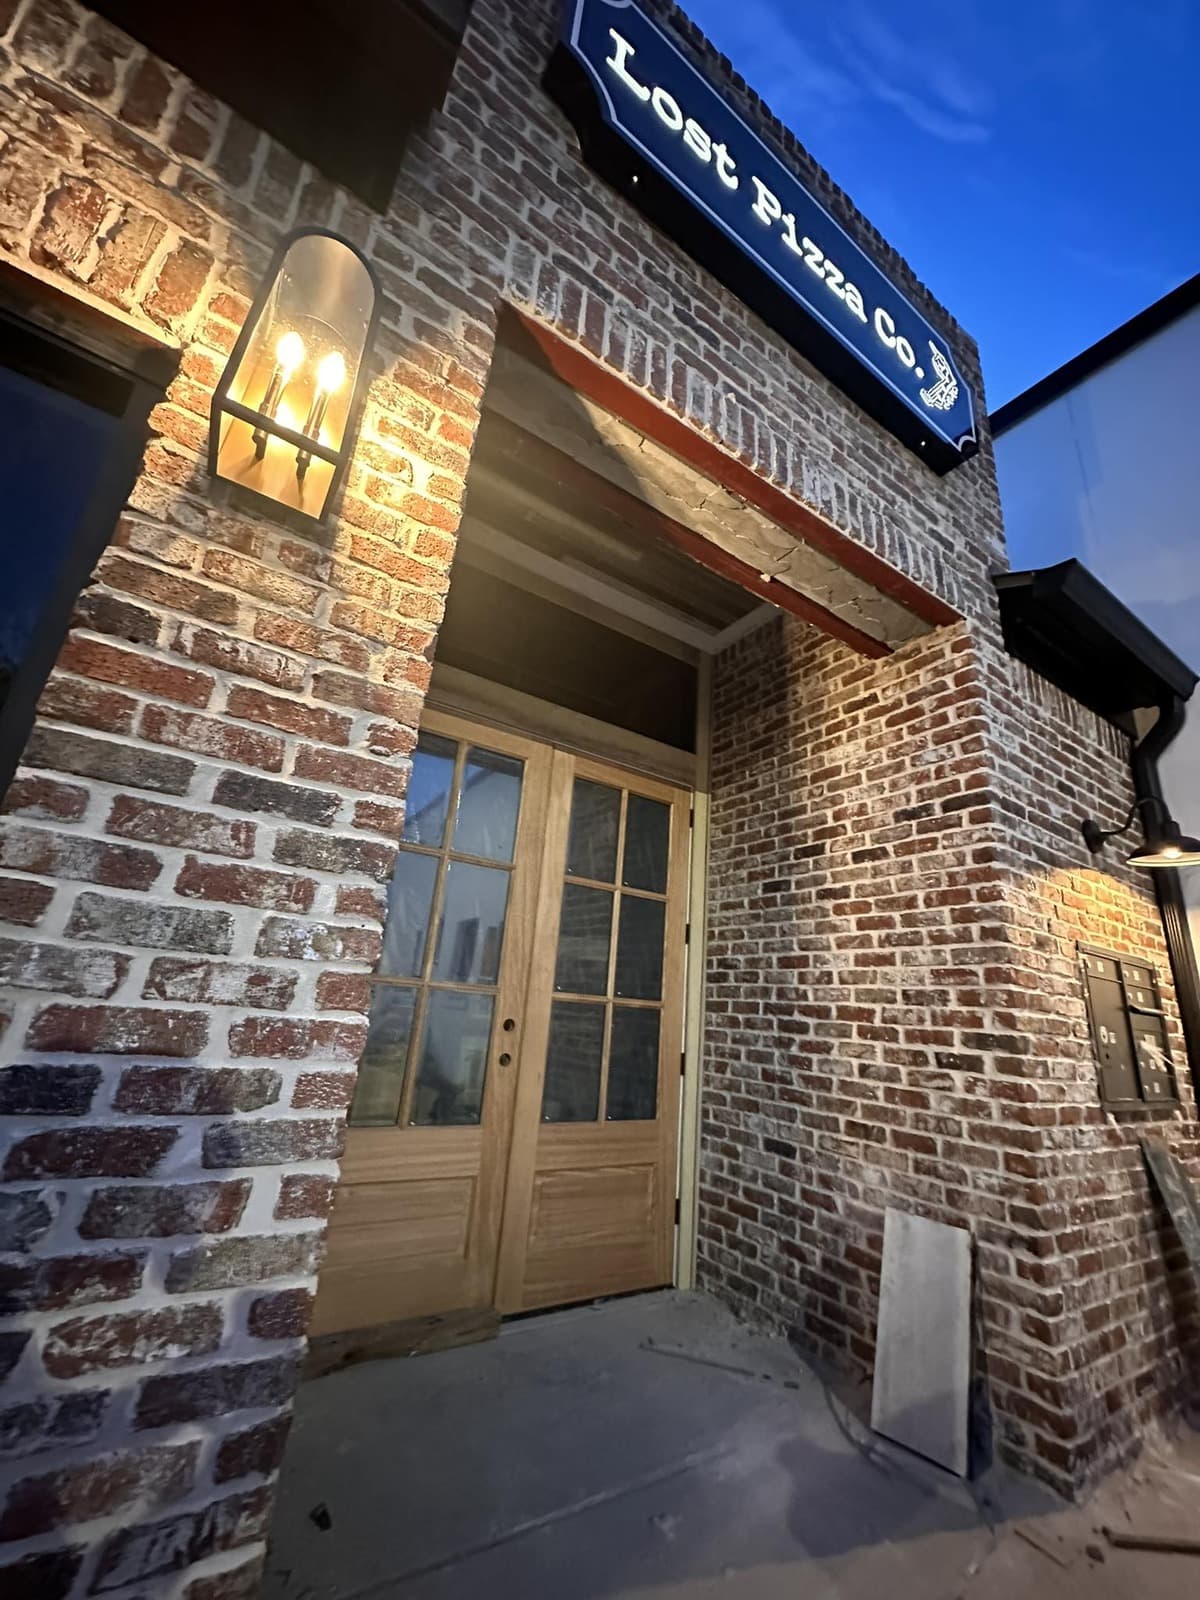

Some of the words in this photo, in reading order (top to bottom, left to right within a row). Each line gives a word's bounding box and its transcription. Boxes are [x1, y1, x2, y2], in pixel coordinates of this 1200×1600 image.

[605, 27, 739, 190] Lost
[751, 175, 868, 323] Pizza
[873, 306, 926, 379] Co.
